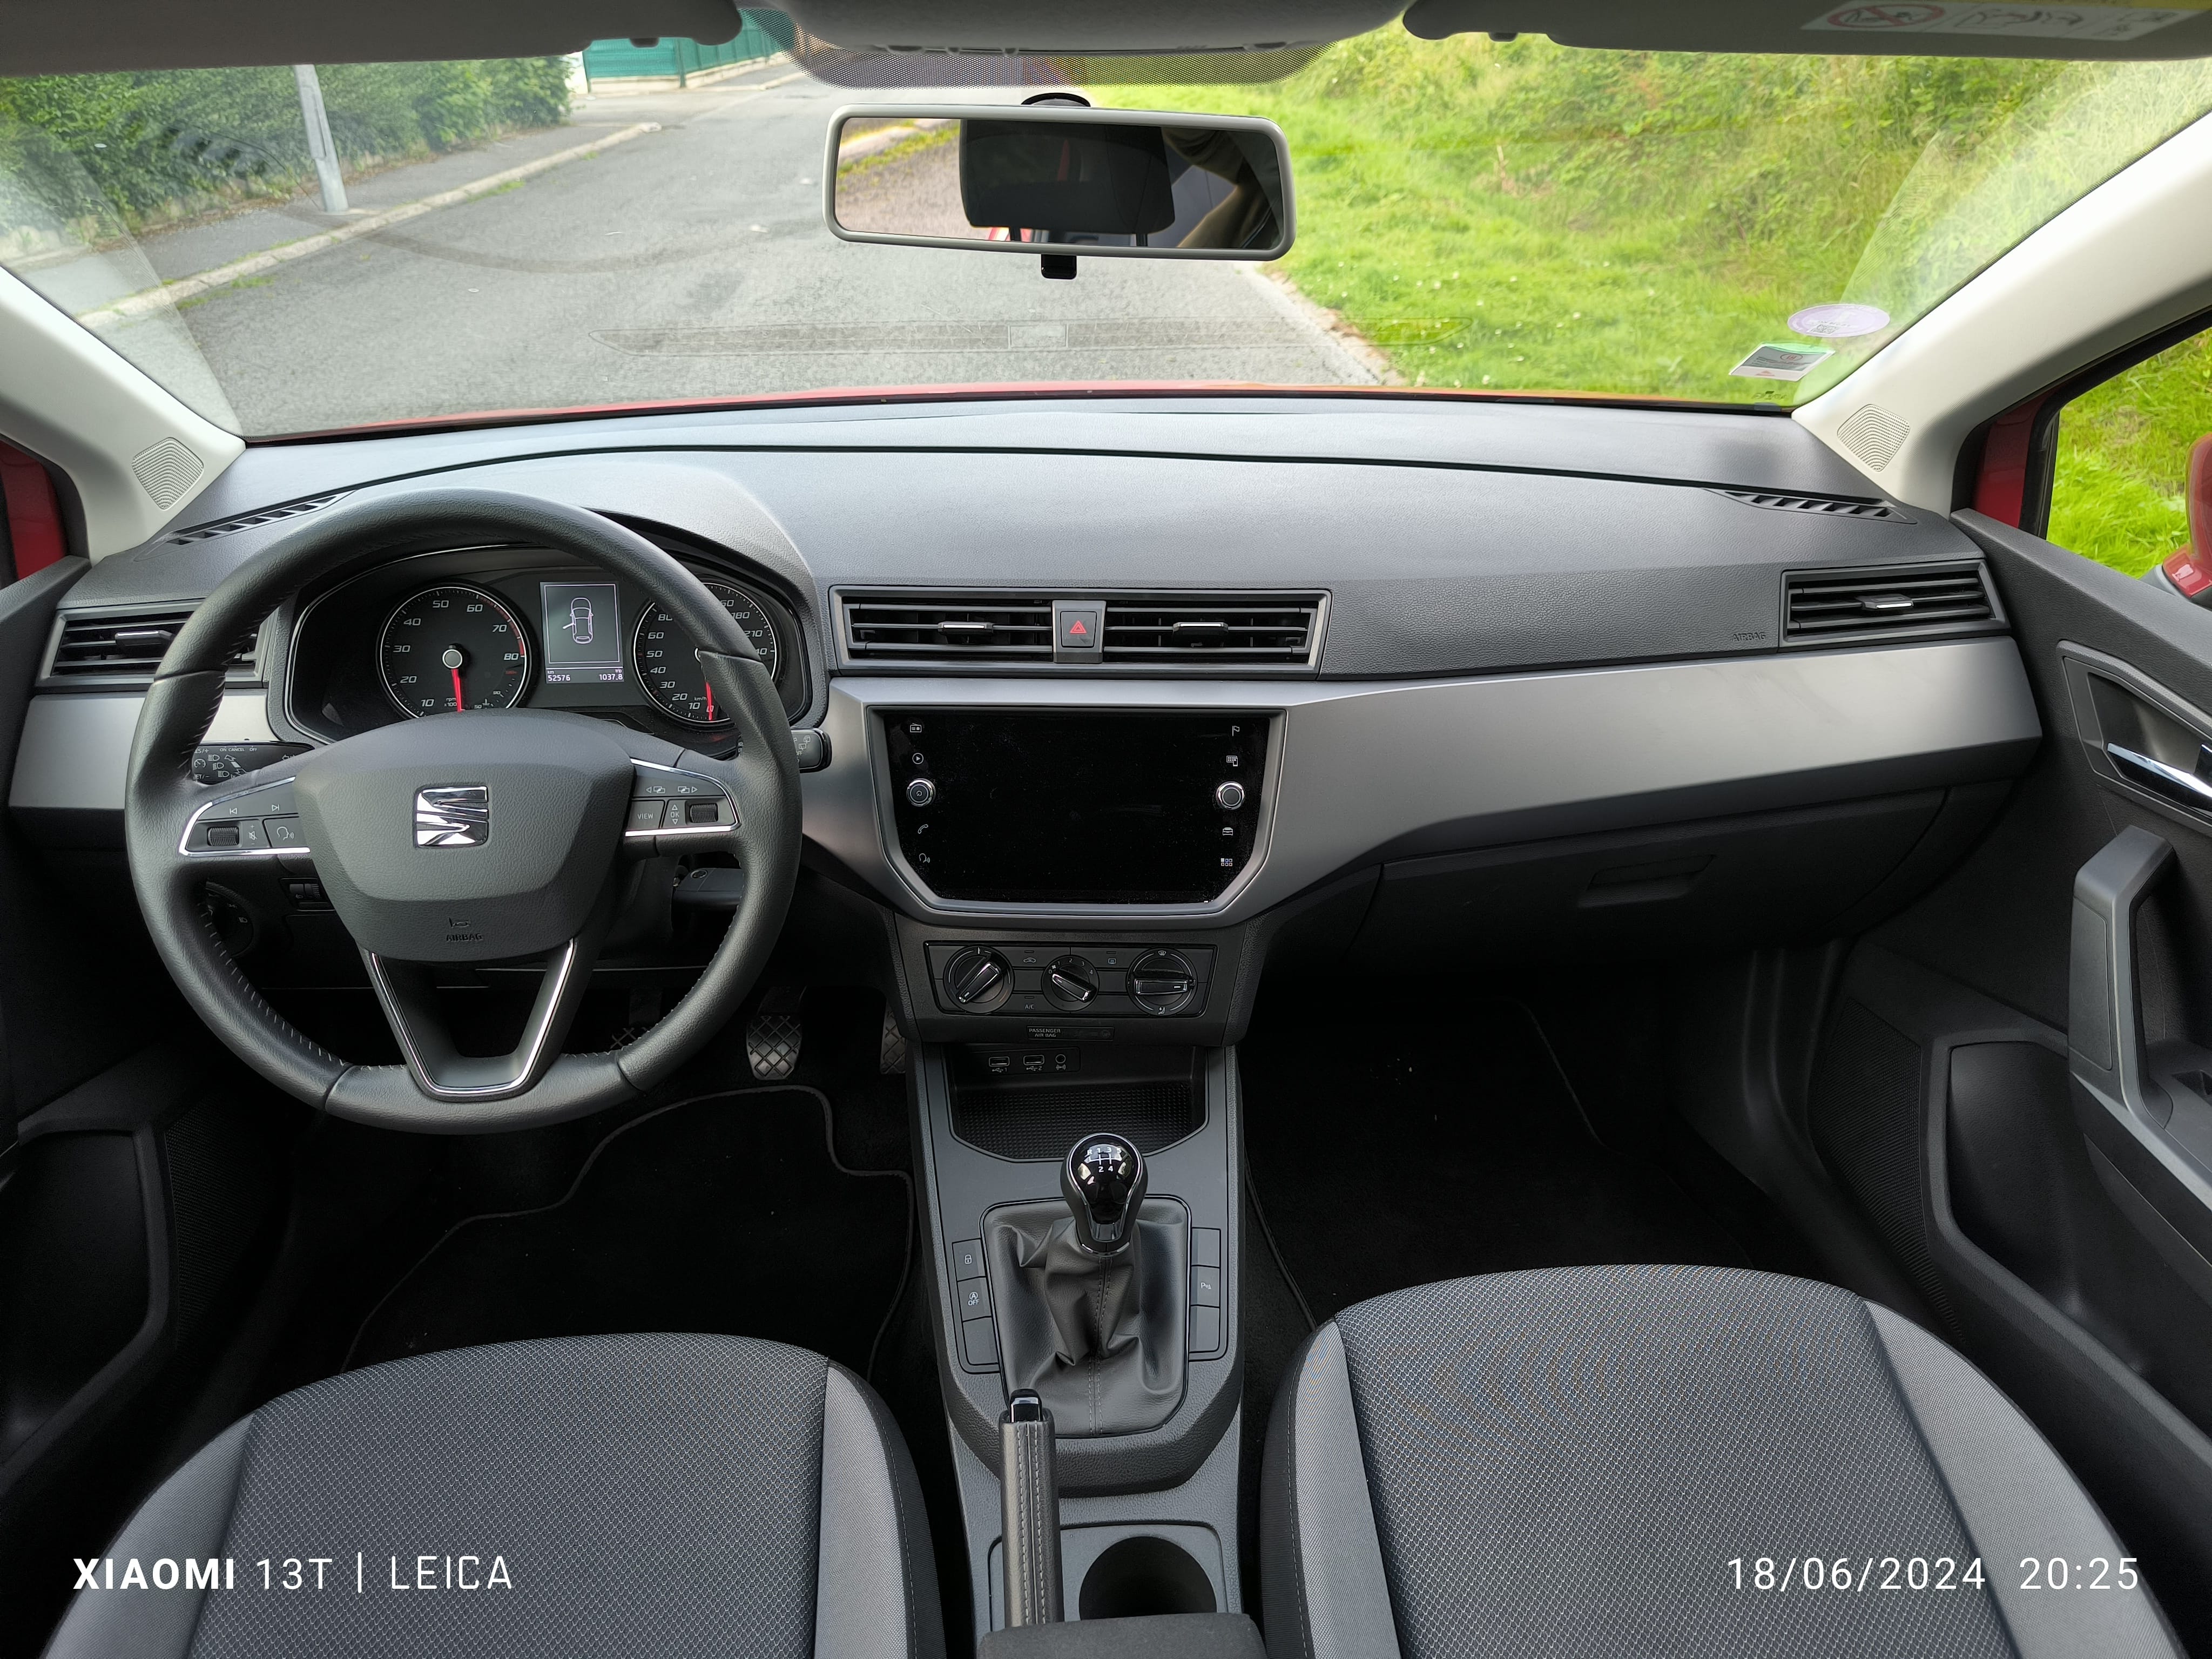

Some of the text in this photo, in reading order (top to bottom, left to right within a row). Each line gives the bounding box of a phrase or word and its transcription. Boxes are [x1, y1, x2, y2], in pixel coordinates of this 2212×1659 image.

[1732, 632, 1766, 642] AIRBAG
[672, 693, 688, 701] 20
[421, 699, 435, 707] 10
[446, 933, 483, 942] AIRBAG
